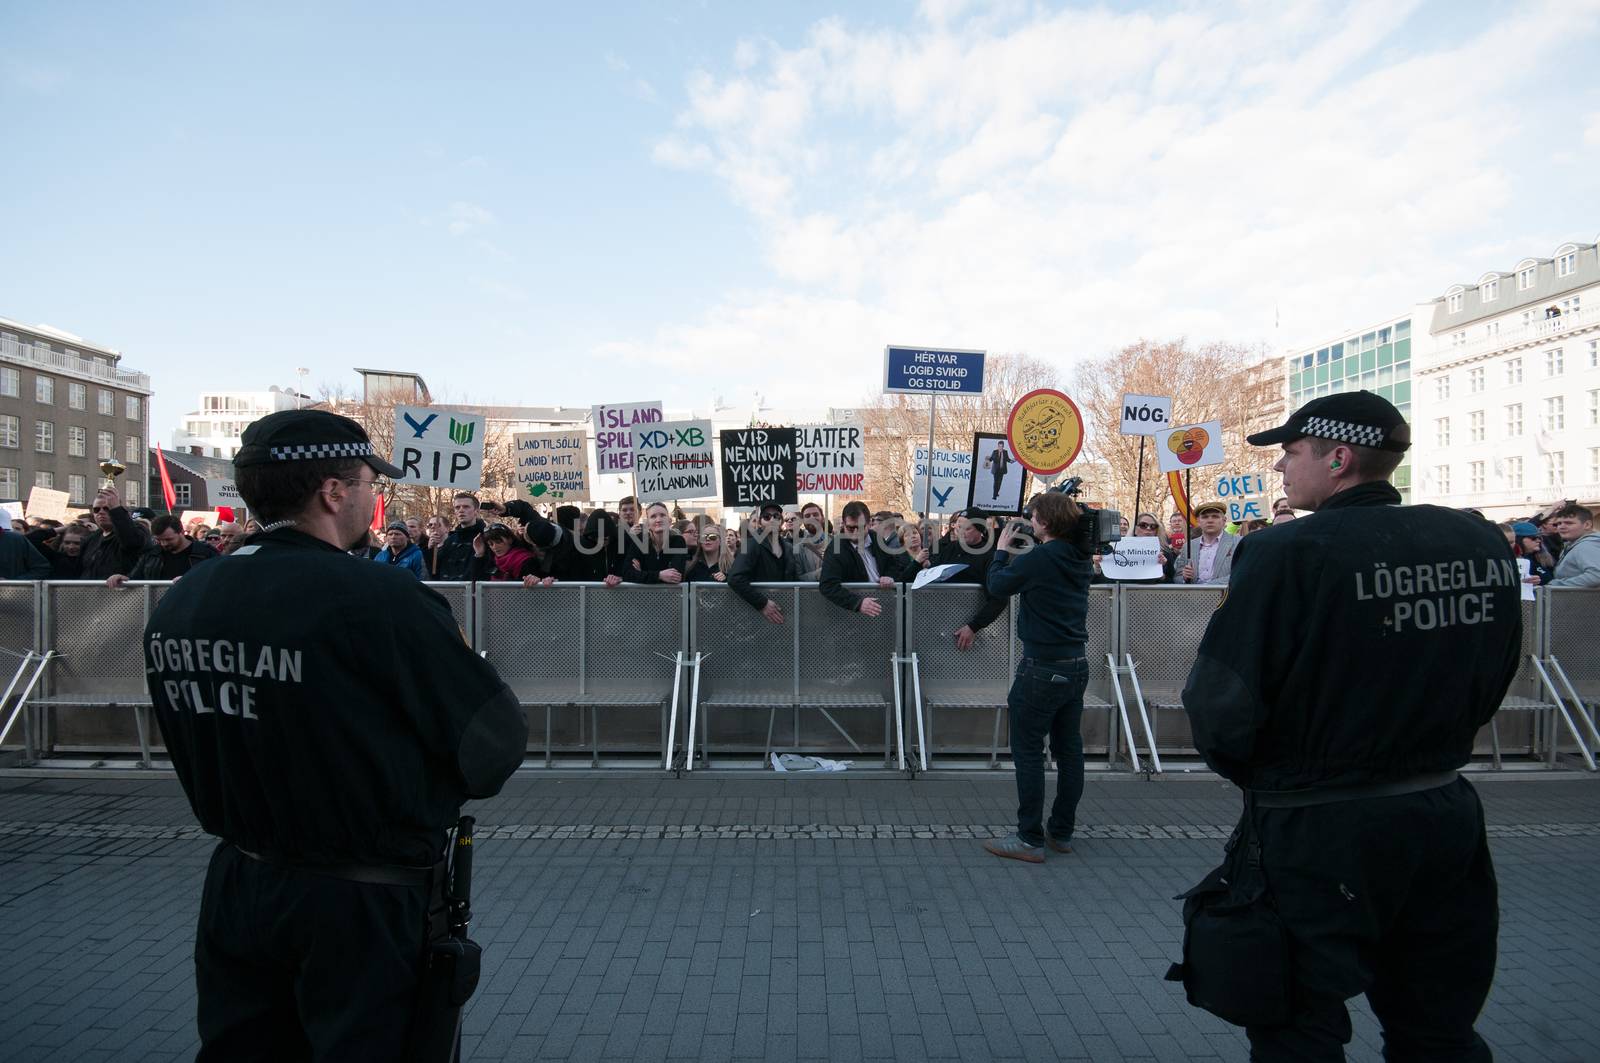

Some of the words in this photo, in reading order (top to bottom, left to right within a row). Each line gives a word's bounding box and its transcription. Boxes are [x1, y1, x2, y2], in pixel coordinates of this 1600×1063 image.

[914, 352, 936, 363] HÉR
[938, 354, 958, 364] VAR
[903, 365, 934, 376] LOGIÐ
[936, 366, 968, 378] SVIKIÐ
[908, 378, 924, 388] OG
[926, 379, 961, 390] STOLIÐ
[599, 405, 662, 428] ÍSLAND
[1124, 403, 1168, 423] NÓG.
[517, 438, 540, 450] LAND
[540, 439, 555, 450] TIL
[738, 430, 768, 446] VIÐ
[796, 428, 860, 448] BLATTER
[518, 455, 548, 466] LANDIÐ
[725, 444, 792, 463] NENNUM
[796, 450, 855, 468] PÚTÍN
[402, 447, 472, 484] RIP
[636, 454, 668, 472] FYRIR
[916, 464, 970, 480] SNLLINGAR
[730, 464, 784, 482] YKKUR
[796, 472, 864, 491] SIGMUNDUR
[738, 484, 776, 502] EKKI
[1229, 502, 1263, 520] BÆ
[1355, 559, 1516, 601] LÖGREGLAN
[1394, 592, 1494, 632] POLICE
